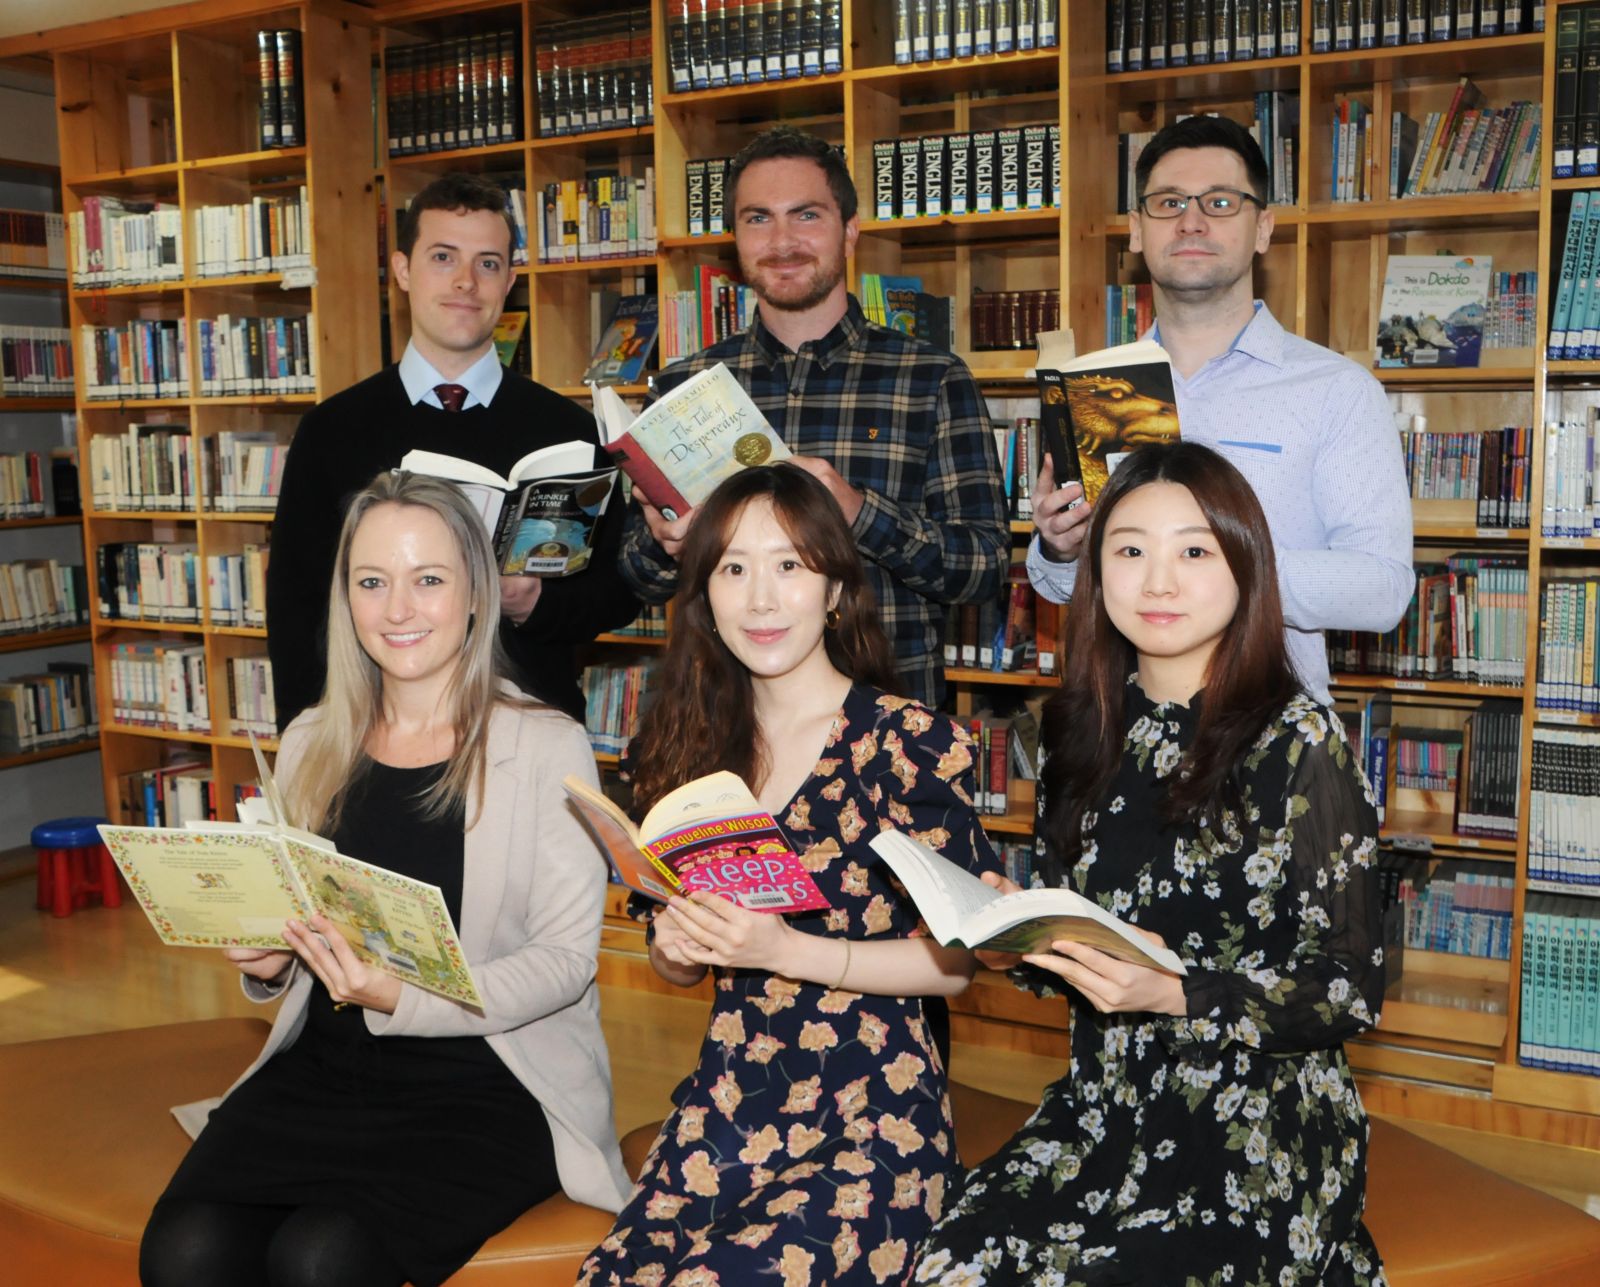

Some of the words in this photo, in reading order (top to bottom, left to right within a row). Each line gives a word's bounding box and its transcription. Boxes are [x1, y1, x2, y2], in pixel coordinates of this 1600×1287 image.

[974, 132, 994, 140] Oxford
[877, 156, 892, 202] ENGLIS
[903, 154, 918, 200] ENGLIS
[926, 152, 941, 198] ENGLIS
[952, 149, 967, 195] ENGLIS
[977, 146, 992, 193] ENGLIS
[1002, 144, 1018, 191] ENGLIS
[1027, 141, 1043, 189] ENGLIS
[689, 176, 703, 218] ENGLIS
[710, 173, 723, 216] ENGLIS
[1428, 272, 1470, 286] Dokdo
[664, 408, 746, 465] Despereaux
[669, 421, 692, 440] The
[690, 406, 712, 426] Tale
[714, 400, 726, 416] of
[1374, 774, 1382, 805] Zealand
[652, 824, 723, 854] Jacqueline
[724, 816, 772, 832] Wilson
